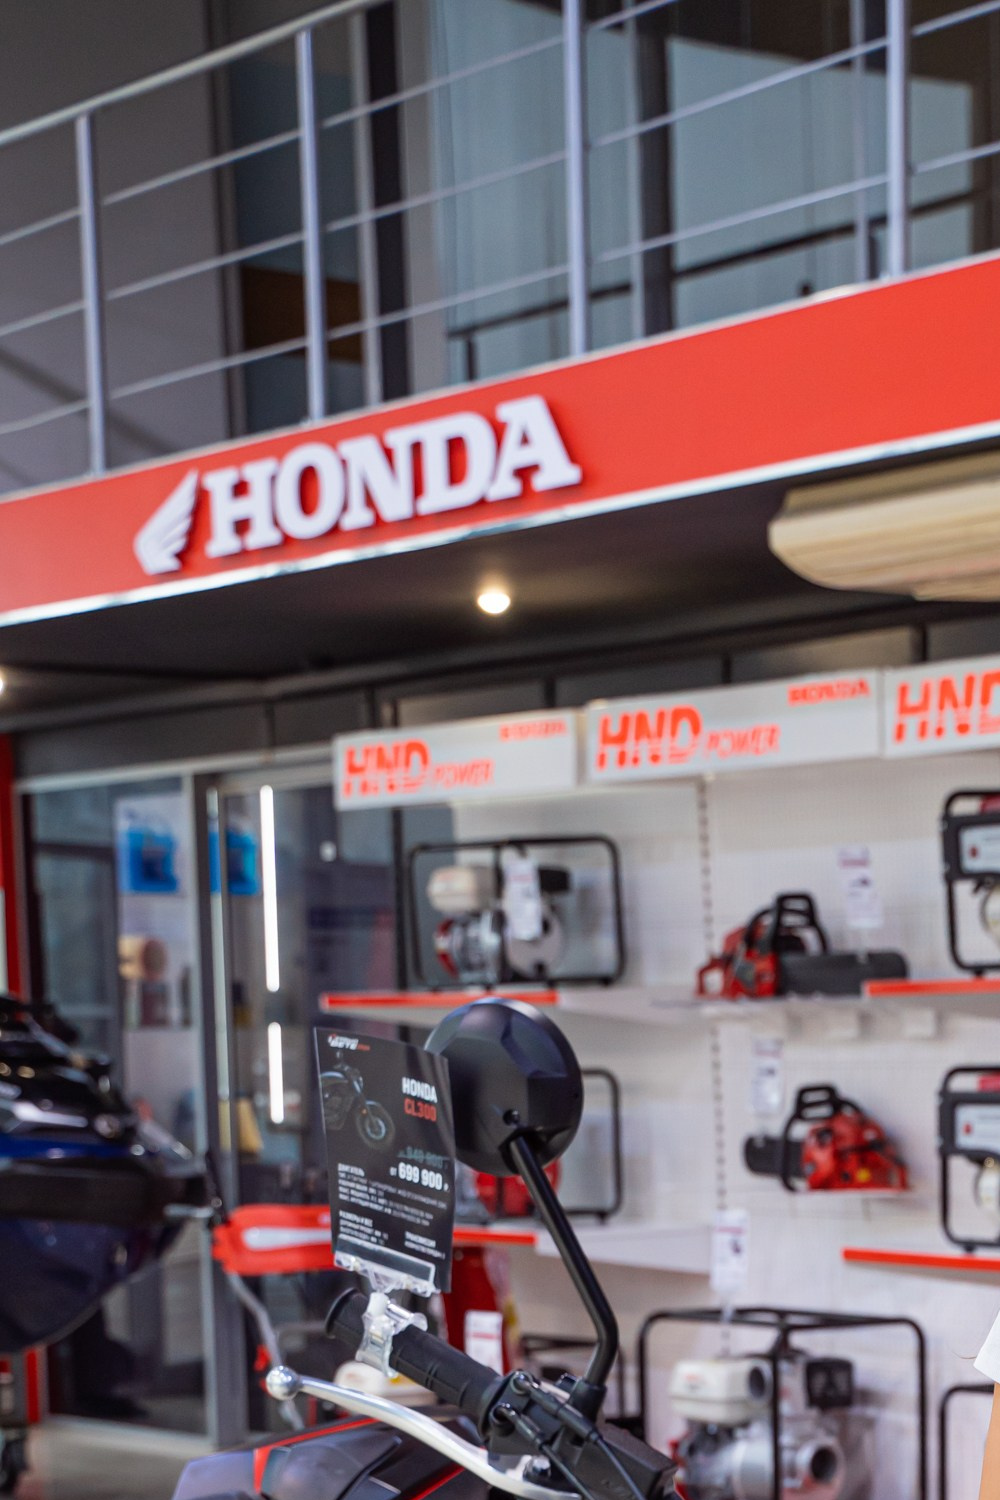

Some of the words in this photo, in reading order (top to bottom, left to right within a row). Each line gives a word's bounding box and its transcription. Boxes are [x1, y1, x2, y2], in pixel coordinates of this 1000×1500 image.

[202, 394, 582, 558] HONDA
[596, 704, 702, 771] HND
[705, 723, 781, 760] POWER
[344, 738, 430, 797] HND
[402, 1077, 438, 1103] HONDA
[404, 1097, 437, 1122] CL300
[398, 1162, 420, 1184] 699
[421, 1168, 443, 1191] 900
